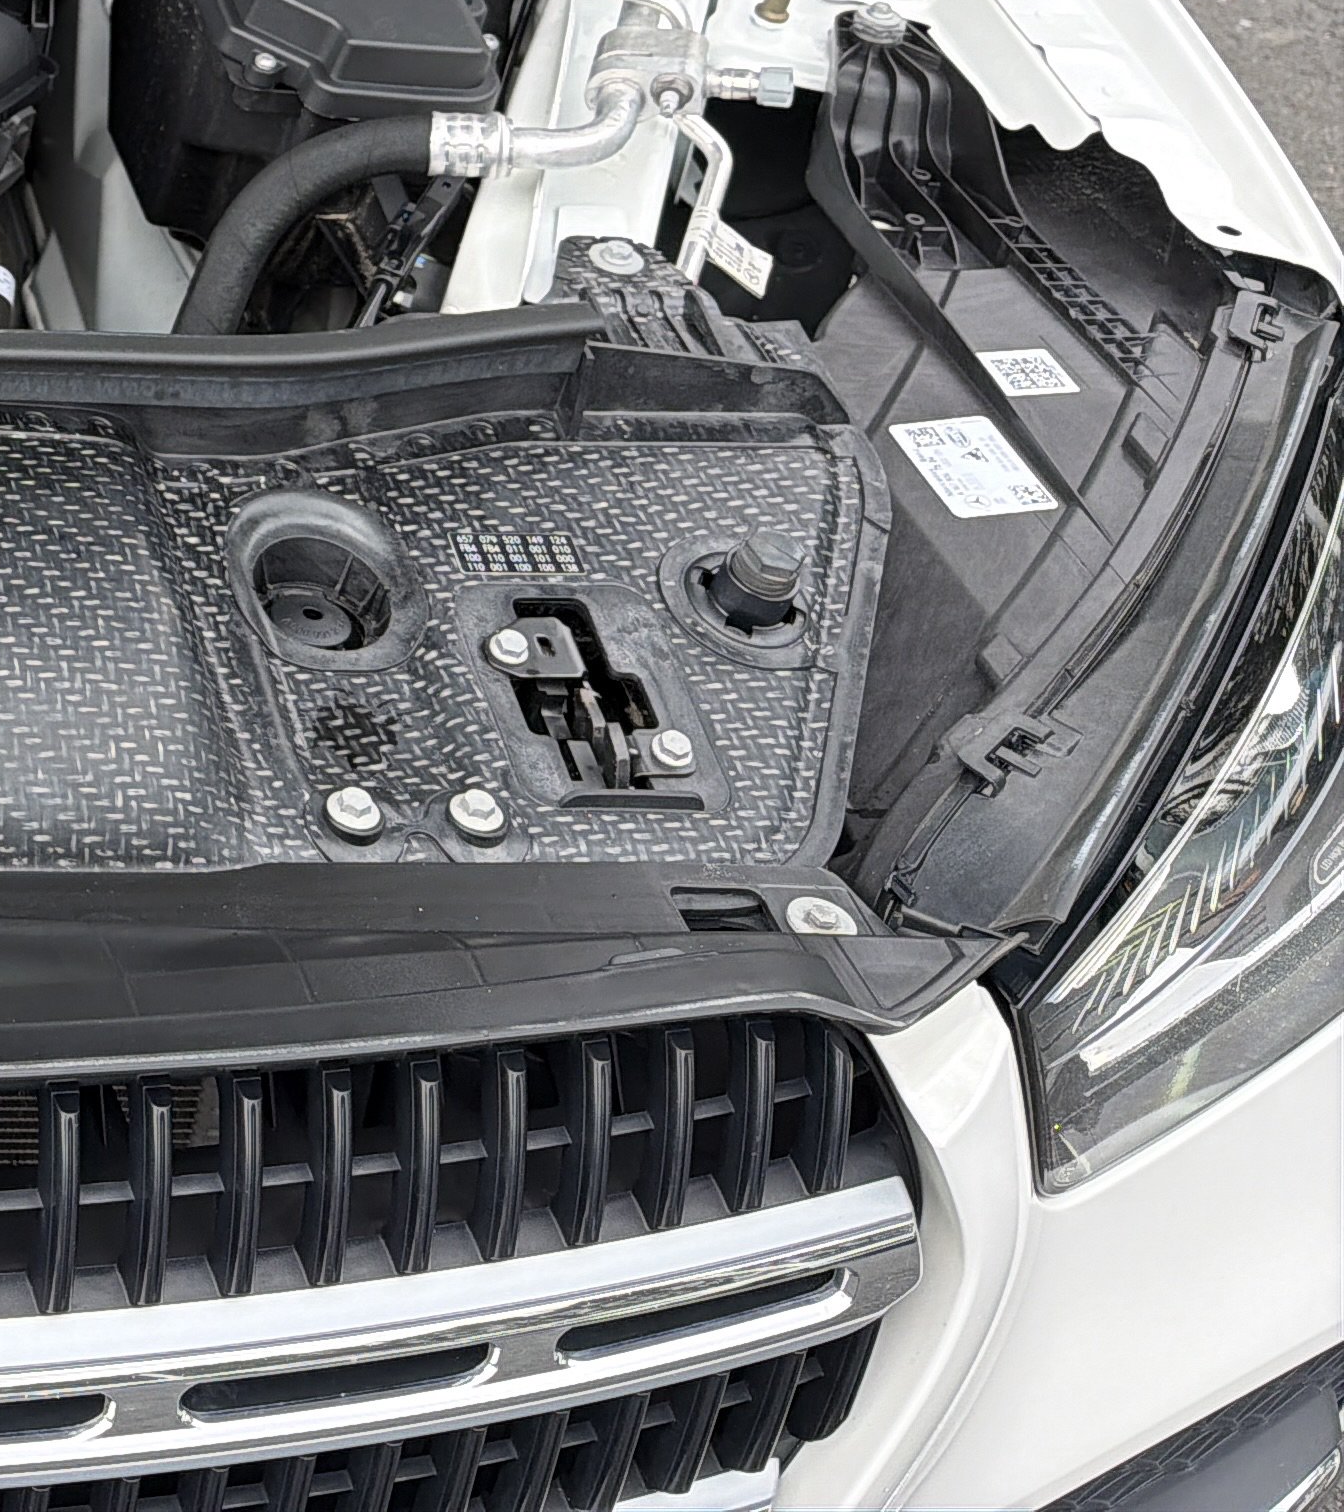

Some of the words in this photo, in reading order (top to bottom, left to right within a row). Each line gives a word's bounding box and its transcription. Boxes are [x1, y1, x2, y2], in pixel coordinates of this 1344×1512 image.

[457, 535, 473, 543] 657
[479, 535, 497, 543] 079
[502, 535, 521, 544] 520
[550, 536, 566, 544] 124
[506, 545, 524, 553] 011
[529, 545, 547, 553] 001
[552, 545, 571, 553] 010
[464, 553, 482, 561] 100
[487, 554, 505, 562] 110
[510, 554, 528, 562] 001
[534, 554, 551, 562] 101
[490, 563, 508, 571] 001
[514, 563, 532, 571] 100
[1319, 856, 1333, 871] LED
